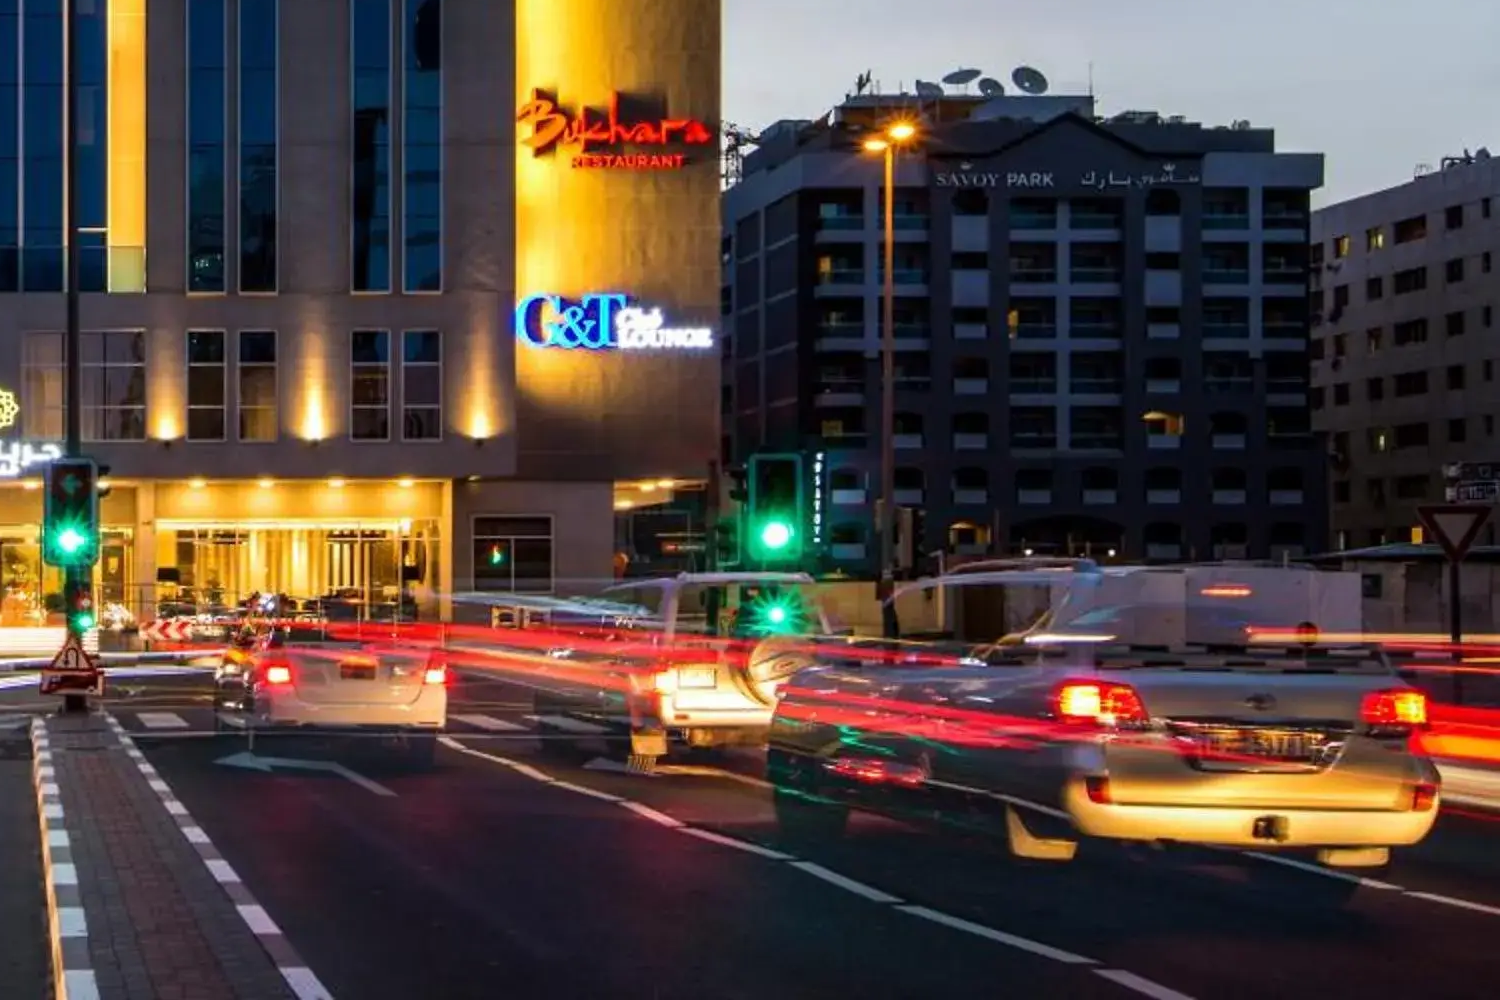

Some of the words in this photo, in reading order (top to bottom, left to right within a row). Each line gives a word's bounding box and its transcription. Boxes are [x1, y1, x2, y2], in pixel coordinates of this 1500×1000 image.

[516, 90, 712, 150] Bukhara
[571, 153, 686, 169] RESTAURANT
[936, 171, 1000, 188] SAVOY
[1006, 171, 1055, 188] PARK
[514, 293, 627, 349] G&T
